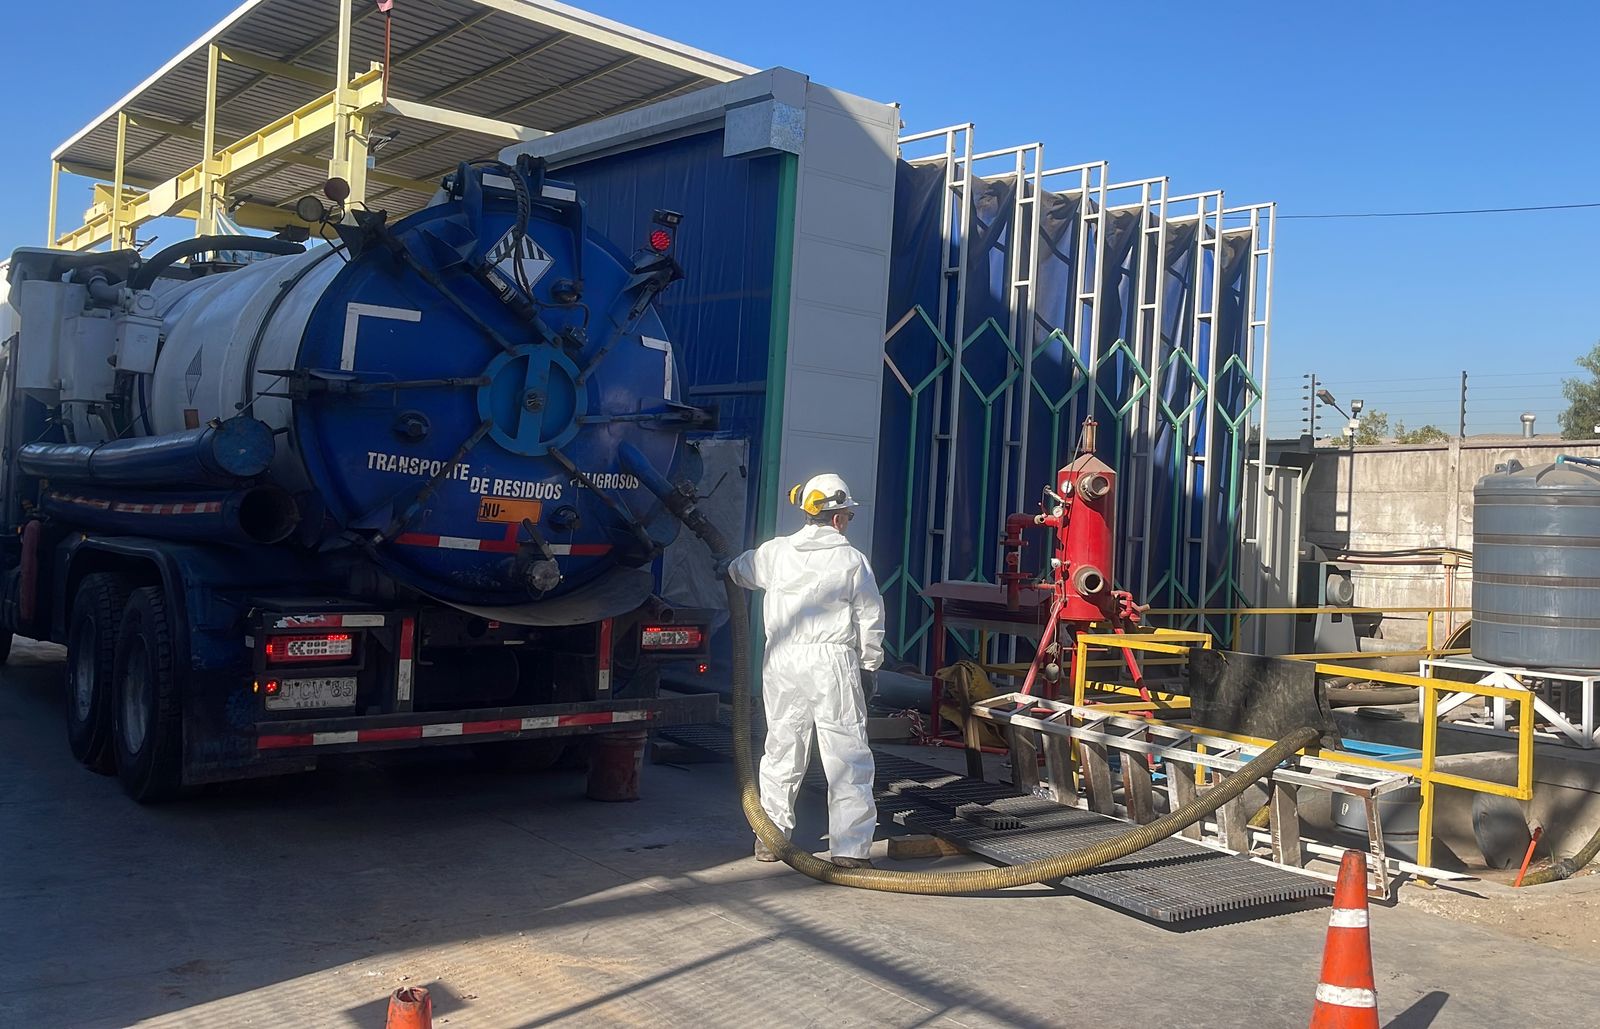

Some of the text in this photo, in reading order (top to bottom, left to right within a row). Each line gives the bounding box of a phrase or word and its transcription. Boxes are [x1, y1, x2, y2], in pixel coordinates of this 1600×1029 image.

[367, 451, 470, 480] TRANSPOTE
[470, 477, 488, 494] DE
[493, 478, 562, 500] RESIDUOS
